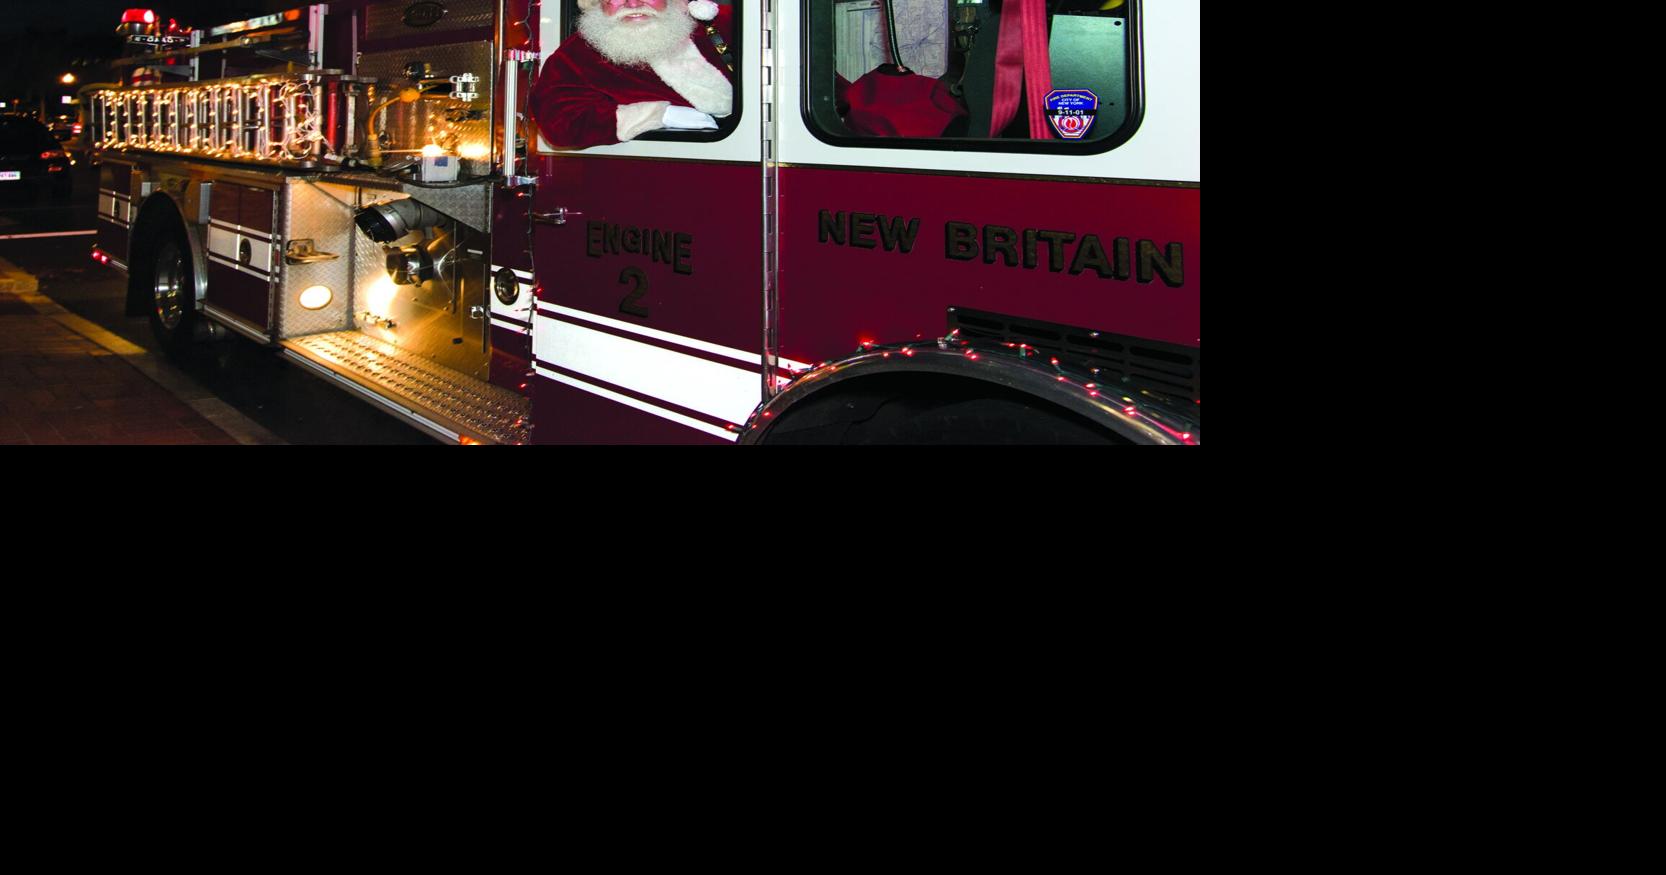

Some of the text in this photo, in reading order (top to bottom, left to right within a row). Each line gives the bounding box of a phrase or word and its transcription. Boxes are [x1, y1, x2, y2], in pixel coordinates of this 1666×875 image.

[587, 221, 692, 275] ENGINE
[818, 209, 1184, 288] NEW BRITAIN
[619, 266, 649, 317] 2
